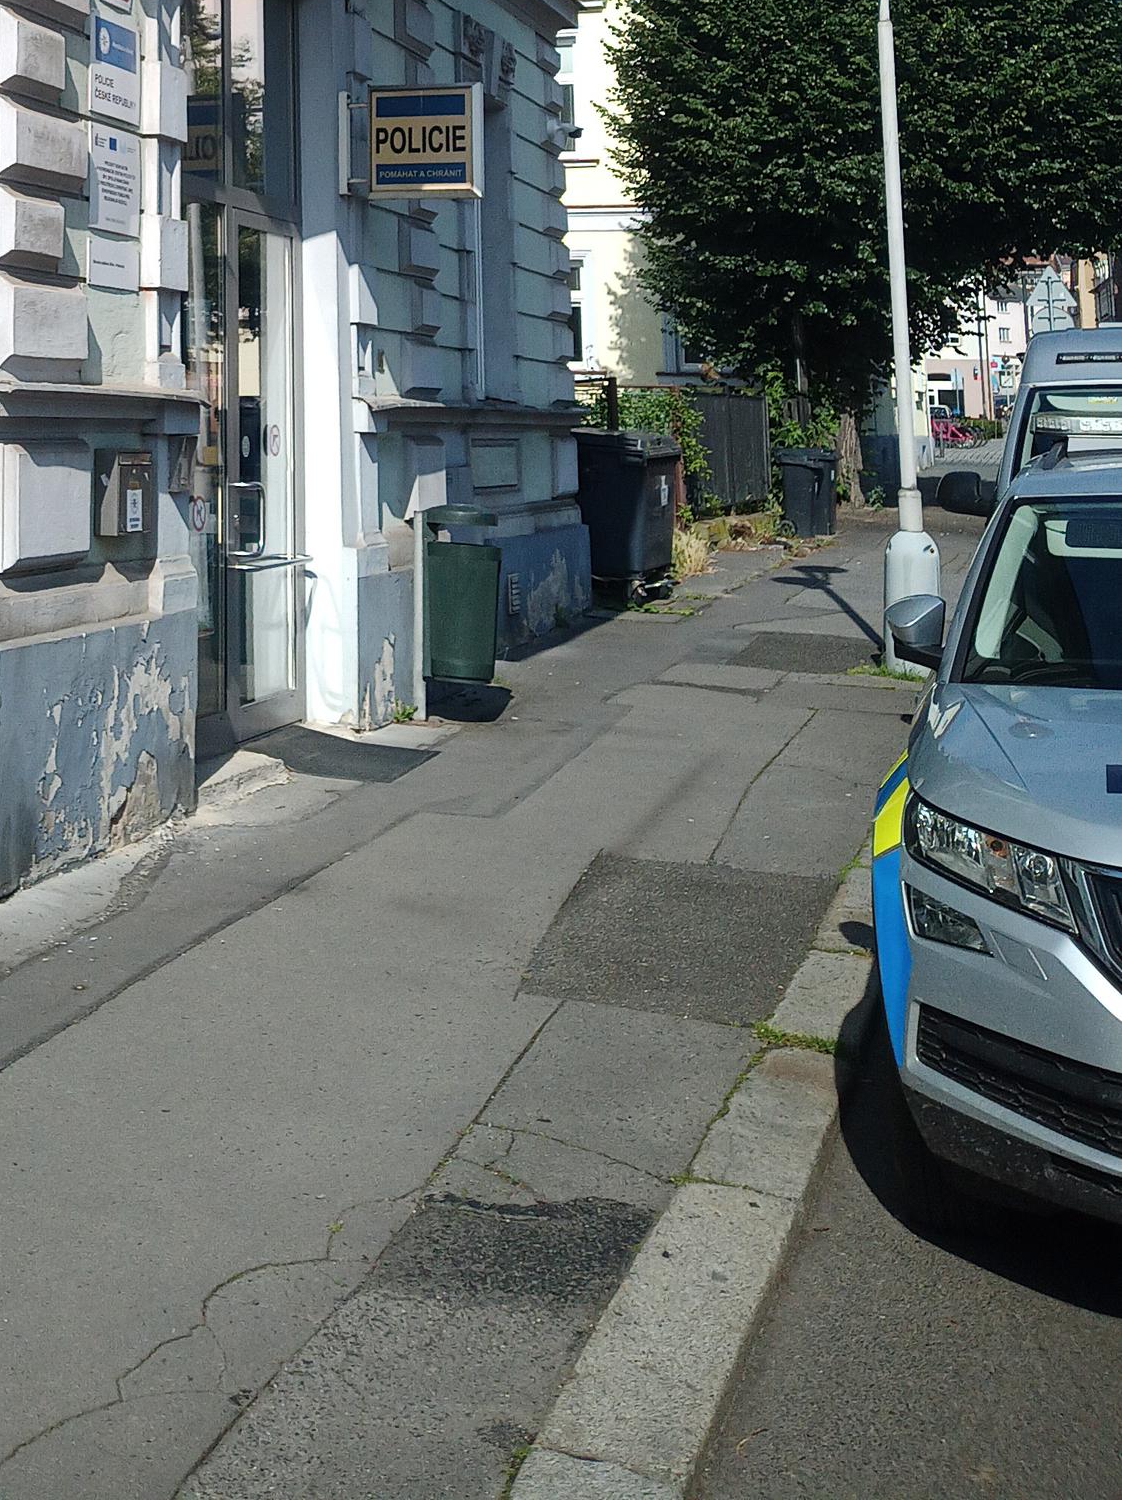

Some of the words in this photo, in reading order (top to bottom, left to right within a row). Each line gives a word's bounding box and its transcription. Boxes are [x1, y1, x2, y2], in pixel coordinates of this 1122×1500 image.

[94, 73, 114, 88] POLICIE
[376, 125, 466, 154] POLICIE
[419, 170, 425, 178] A
